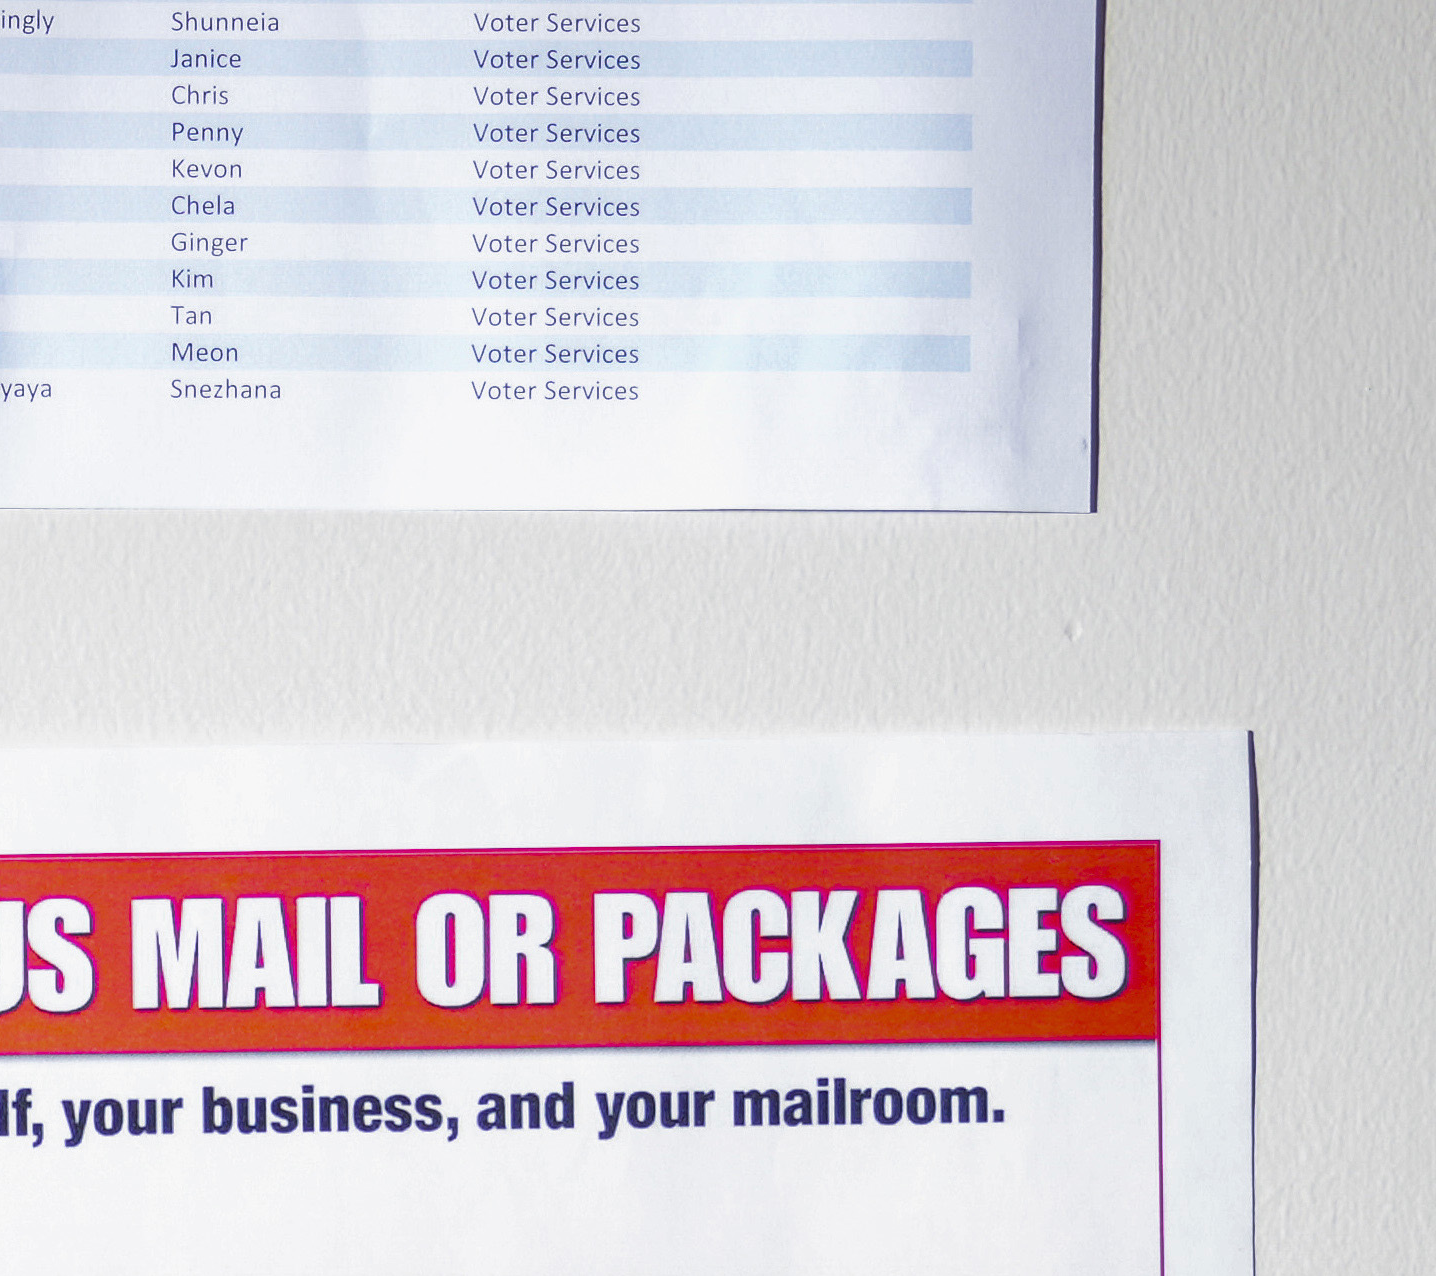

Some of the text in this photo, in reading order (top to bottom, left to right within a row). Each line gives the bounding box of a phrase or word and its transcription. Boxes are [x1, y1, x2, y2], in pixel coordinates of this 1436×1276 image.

[170, 48, 242, 69] Janice
[473, 49, 540, 69] Voter
[546, 49, 641, 70] Services
[172, 122, 244, 147] Penny
[472, 123, 539, 143] Voter
[546, 123, 640, 144] Services
[171, 194, 235, 216] Chela
[472, 196, 539, 217] Voter
[545, 196, 640, 217] Services
[172, 268, 214, 289] Kim
[471, 270, 538, 290] Voter
[544, 270, 640, 291] Services
[170, 378, 281, 400] Snezhana
[471, 380, 537, 400] Voter
[544, 380, 639, 401] Services
[130, 895, 382, 1011] MAIL
[415, 890, 558, 1010] OR
[592, 884, 1129, 1004] PACKAGES
[61, 1097, 184, 1148] your
[202, 1084, 459, 1143] business,
[476, 1081, 575, 1132] and
[595, 1089, 716, 1141] your
[733, 1077, 1005, 1127] mailroom.
